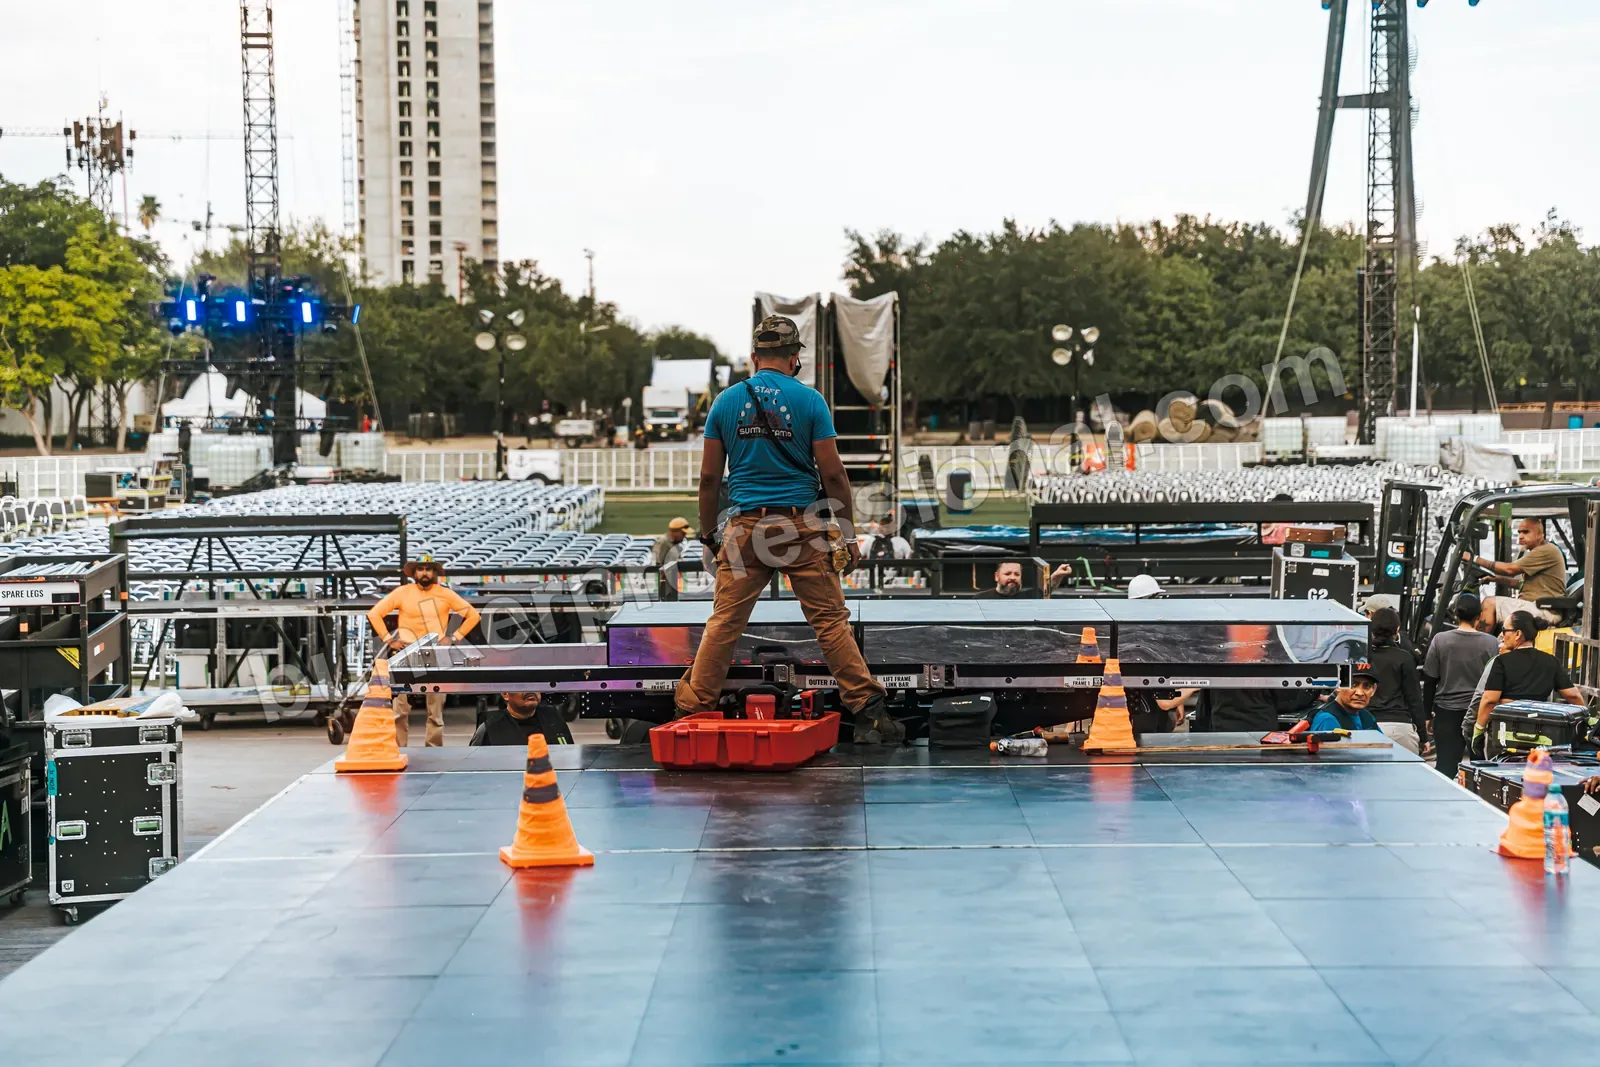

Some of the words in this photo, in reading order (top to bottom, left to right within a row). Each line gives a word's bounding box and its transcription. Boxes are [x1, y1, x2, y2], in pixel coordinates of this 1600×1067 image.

[755, 386, 781, 396] STAFF
[1387, 564, 1401, 575] 25
[1, 590, 25, 599] SPARE
[26, 589, 44, 598] LEGS
[808, 678, 829, 686] OUTER
